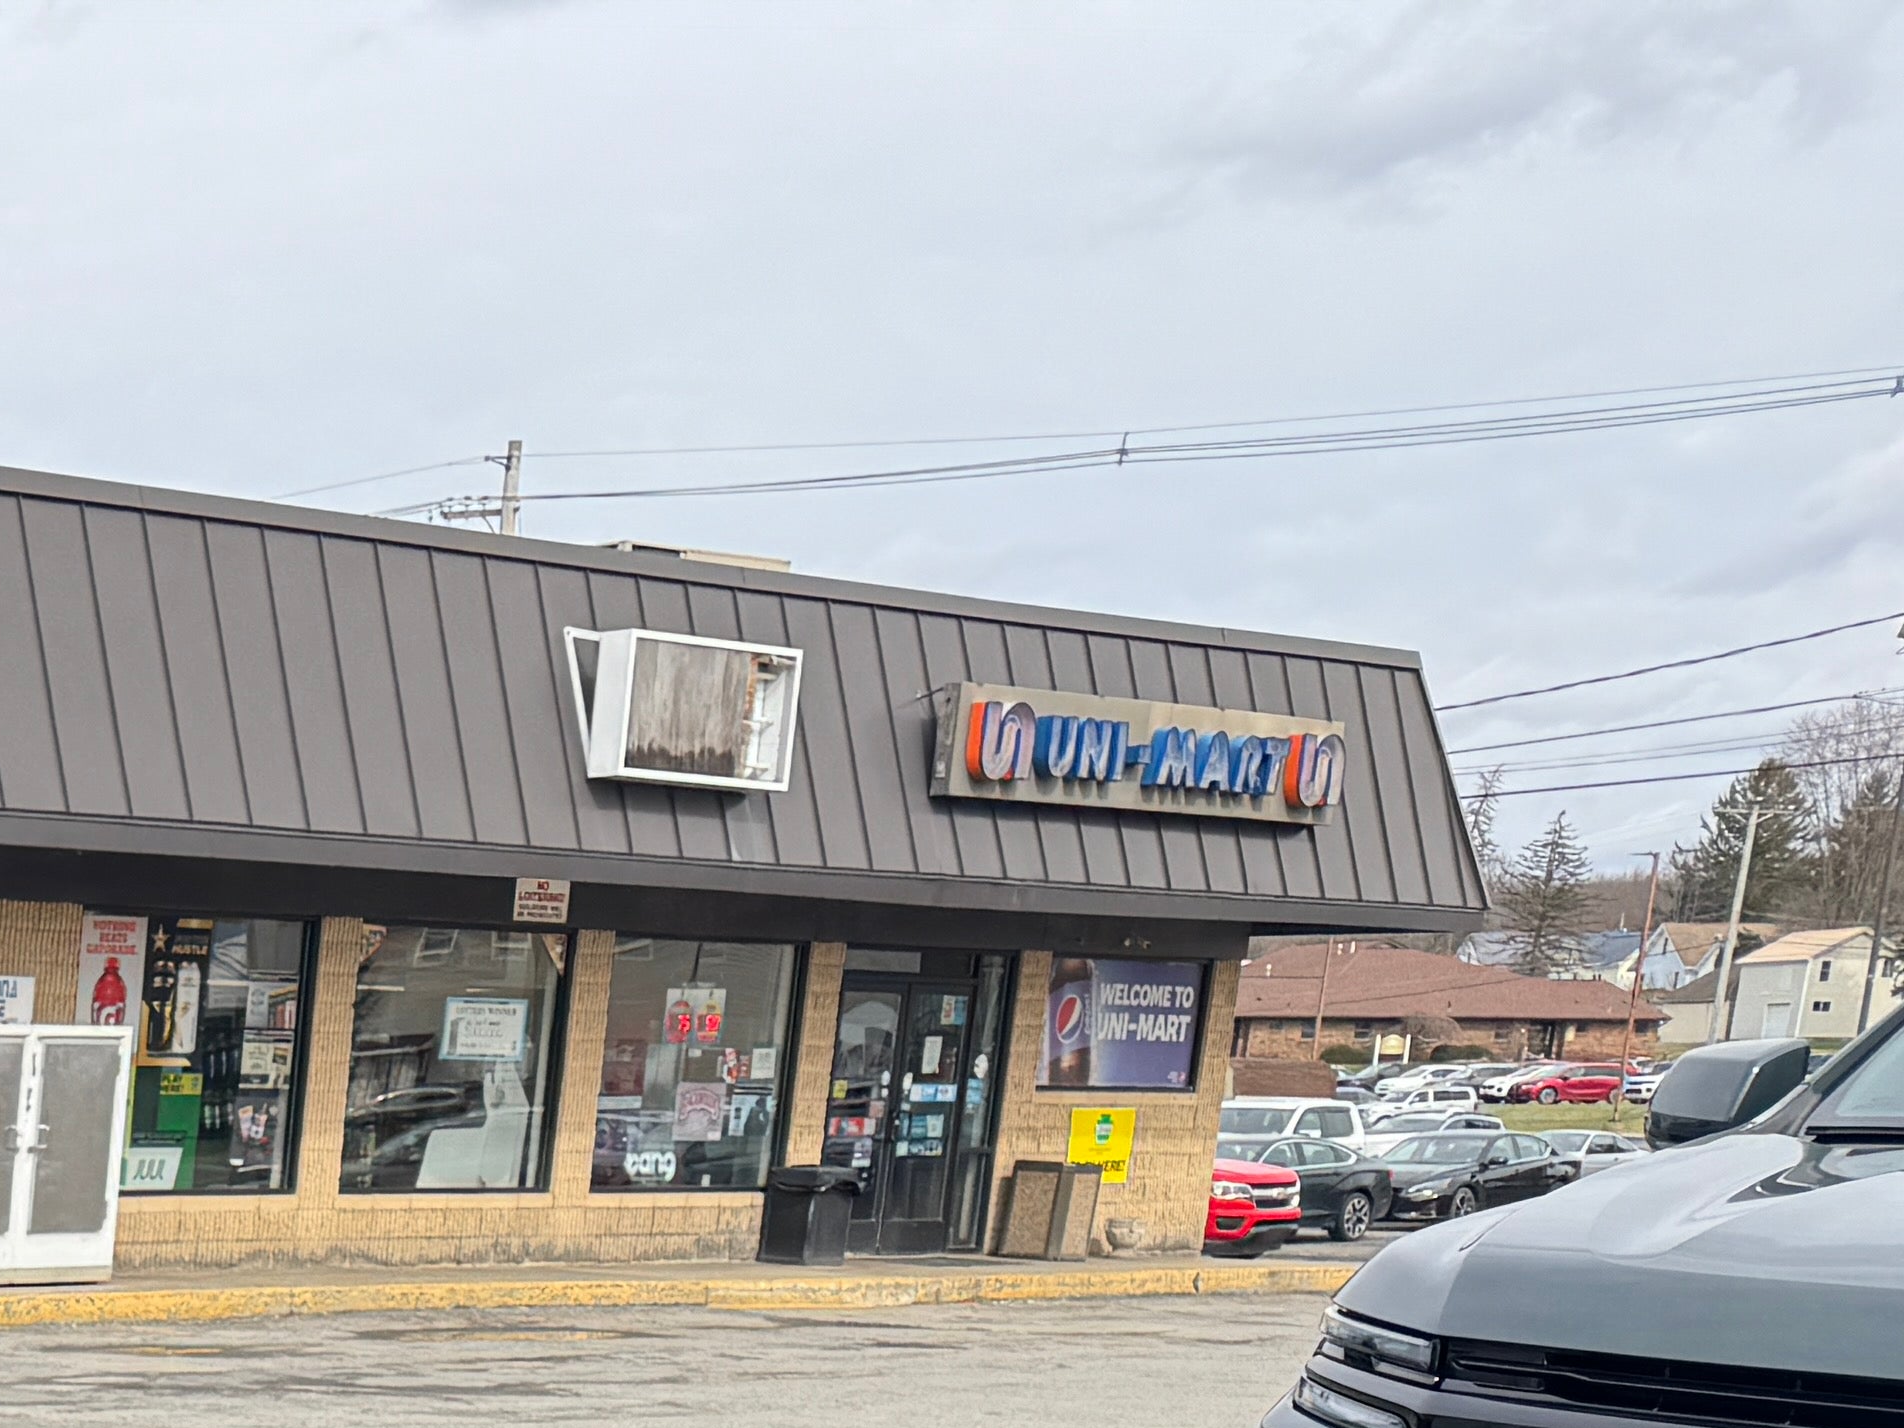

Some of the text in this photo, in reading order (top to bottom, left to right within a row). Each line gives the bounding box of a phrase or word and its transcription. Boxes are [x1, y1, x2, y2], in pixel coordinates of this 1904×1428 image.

[1035, 713, 1290, 797] UNI-MART
[1100, 983, 1194, 1008] WELCOME TO
[1097, 1011, 1192, 1042] UNI-MART
